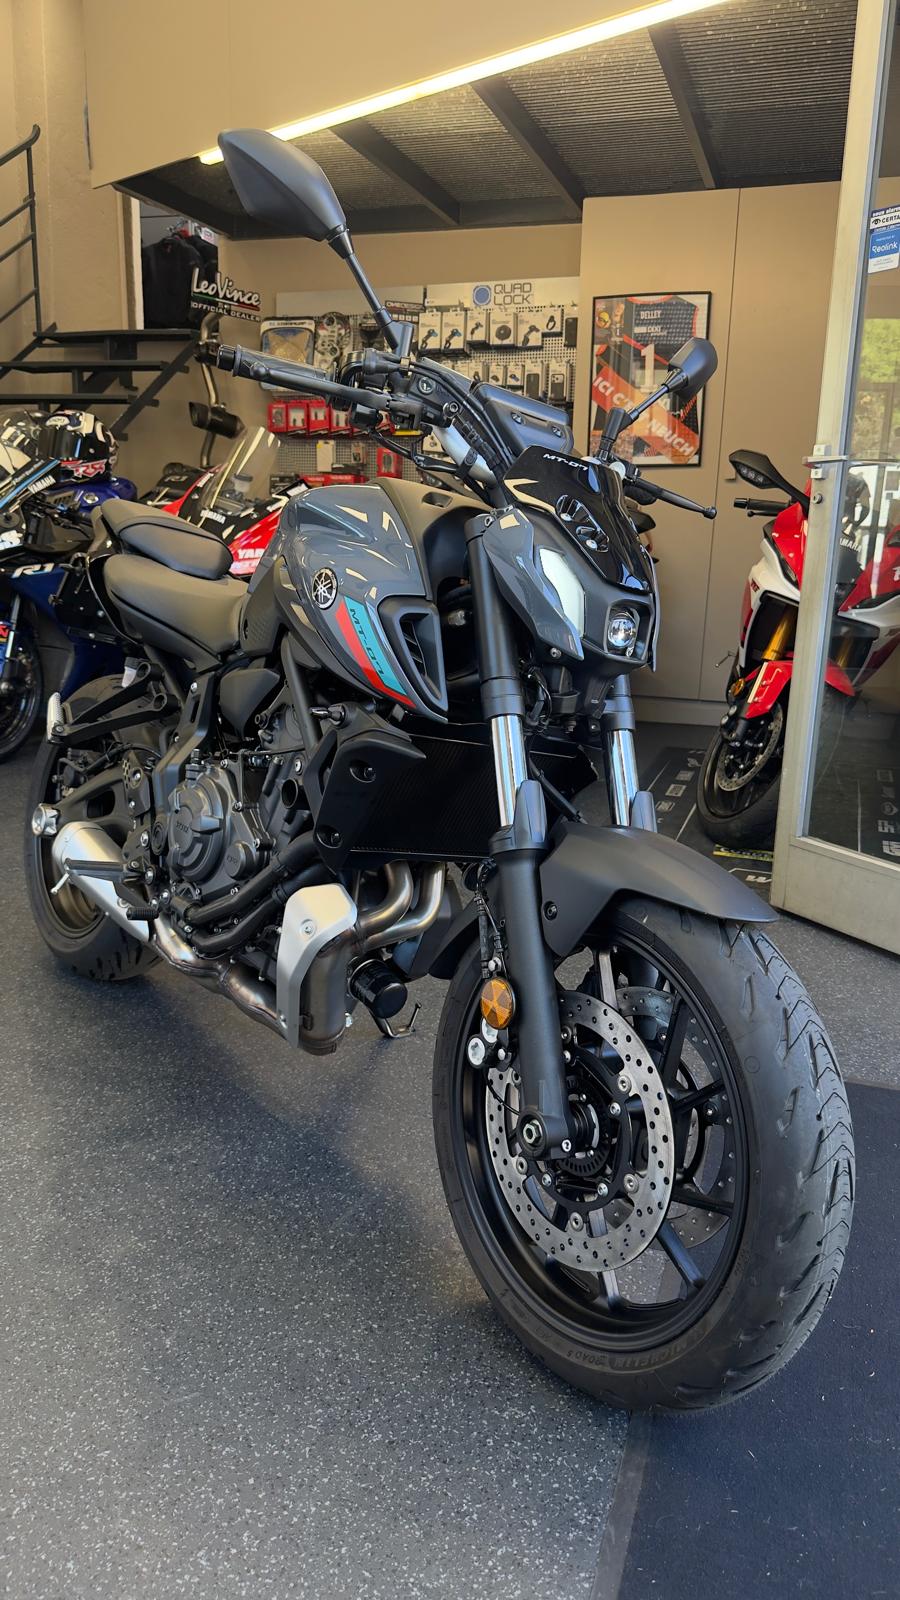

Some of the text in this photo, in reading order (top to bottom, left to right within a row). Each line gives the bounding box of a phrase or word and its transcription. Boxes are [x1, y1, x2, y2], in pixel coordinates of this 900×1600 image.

[193, 267, 261, 305] LeoVince
[493, 282, 532, 295] QUAD
[493, 293, 531, 306] LOCK
[192, 302, 261, 322] OFFICIAL DEALER
[593, 376, 615, 396] ICI
[542, 453, 589, 471] MT-07
[27, 474, 57, 495] YAMAHA
[199, 509, 227, 524] YAMAHA
[11, 563, 54, 578] R1
[350, 609, 385, 675] MT-07
